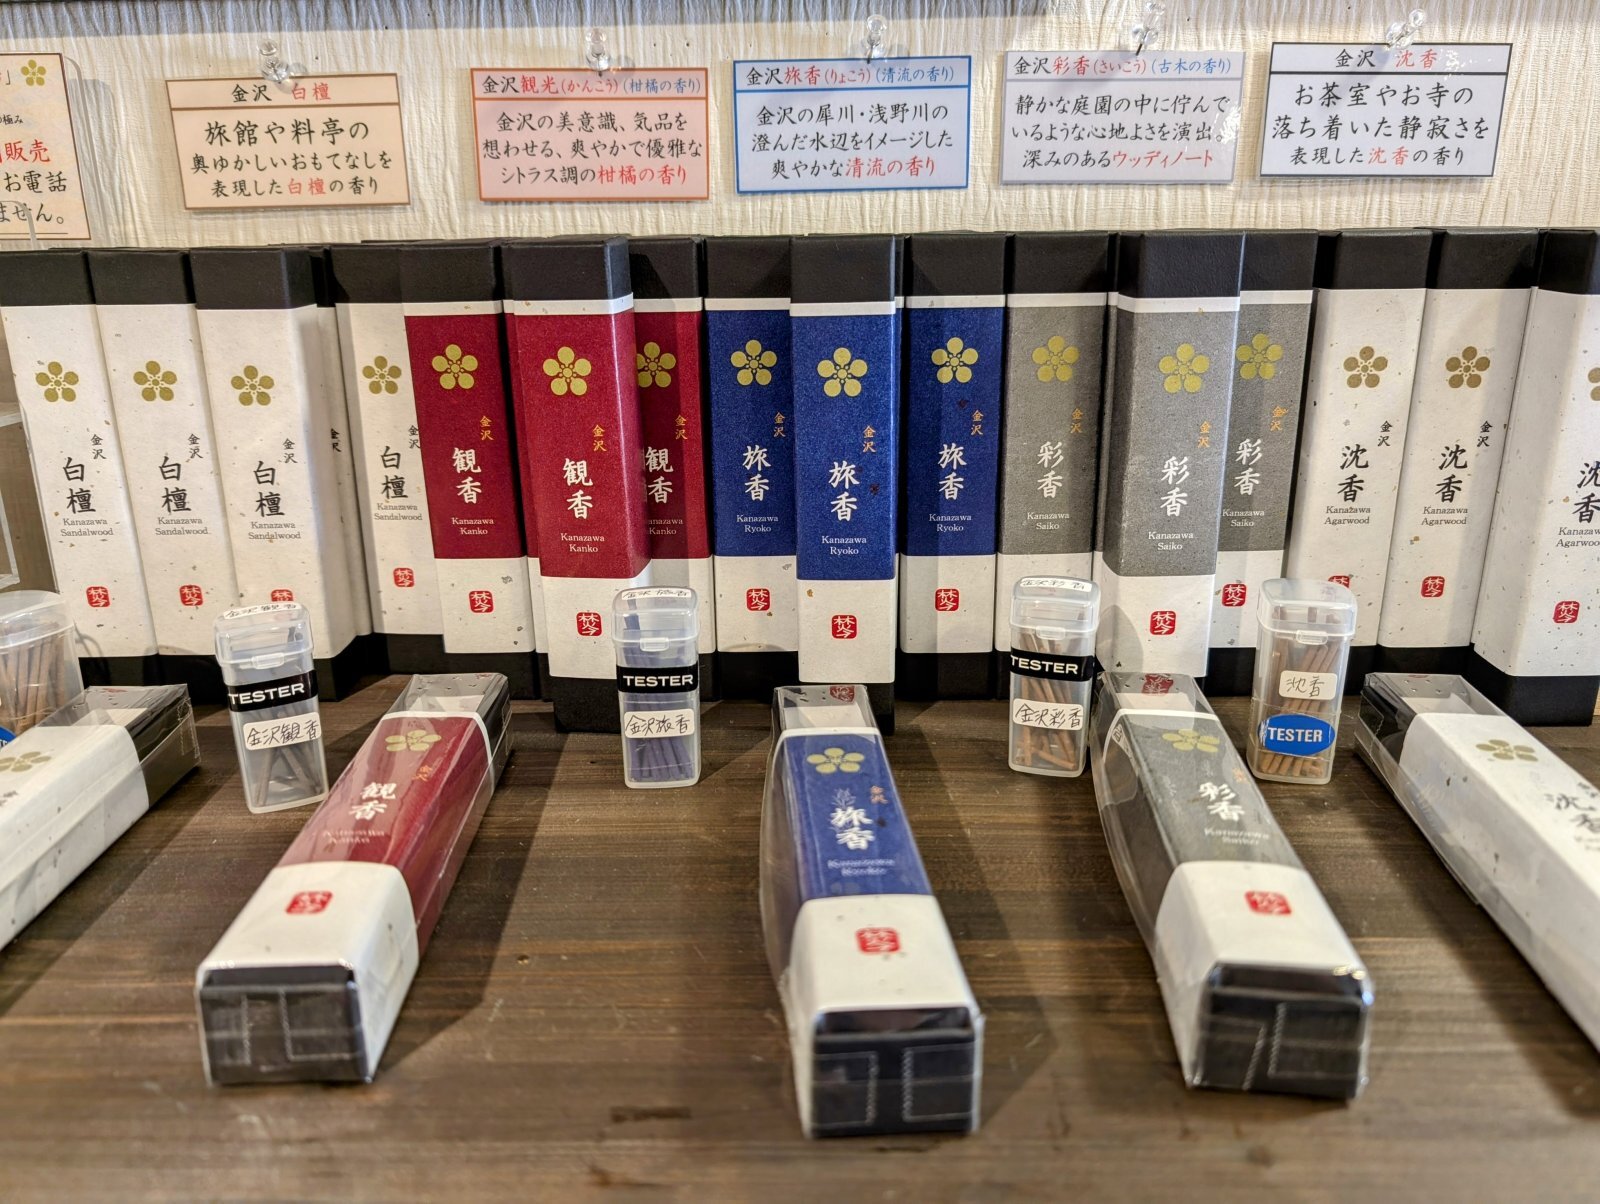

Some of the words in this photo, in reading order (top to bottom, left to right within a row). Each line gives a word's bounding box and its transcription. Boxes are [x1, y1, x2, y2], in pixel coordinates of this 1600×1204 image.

[1335, 48, 1375, 68] 金沢
[1395, 49, 1438, 68] 沈香
[231, 84, 272, 103] 金沢
[291, 82, 332, 101] 白檀
[1294, 82, 1473, 108] お茶室やお寺の
[756, 103, 948, 126] 金沢の犀川・浅野川の
[1015, 93, 1230, 116] 静かな庭園の中に佇んで
[0, 114, 24, 124] 極み
[497, 111, 688, 133] 金沢の美意識、気品を
[1272, 115, 1489, 141] 落ち着いた静寂さを
[204, 118, 370, 147] 旅館や料亭の
[751, 130, 953, 152] 澄んだ水辺をイメージした
[1011, 122, 1224, 142] いるような心地よさを演出。
[0, 139, 51, 164] 販売
[482, 138, 703, 160] 想わせる、爽やかで優雅な
[1022, 149, 1213, 169] 深みのあるウッディノート
[1290, 146, 1463, 166] 表現した沈香の香り
[190, 151, 392, 175] 奥ゆかしいおもてなしを
[771, 155, 935, 180] 爽やかな清流の香り
[3, 170, 67, 193] お電話
[501, 164, 687, 186] シトラス調の柑橘の香り
[211, 176, 379, 197] 表現した白檀の香り
[479, 415, 494, 441] 金沢
[675, 414, 688, 440] 金沢
[774, 412, 787, 438] 金沢
[970, 410, 984, 436] 金沢
[1070, 408, 1083, 434] 金沢
[1270, 405, 1287, 431] 金沢
[408, 425, 421, 449] 金沢
[592, 425, 607, 452] 金沢
[863, 425, 876, 453] 金沢
[1198, 421, 1212, 448] 金沢
[1377, 420, 1393, 447] 金沢
[1477, 420, 1493, 448] 金沢
[91, 433, 107, 460] 金沢
[188, 433, 204, 459] 金沢
[282, 438, 299, 464] 金沢
[381, 445, 409, 500] 白檀
[452, 447, 482, 504] 観香
[645, 446, 674, 504] 観香
[742, 444, 771, 502] 旅香
[938, 443, 967, 501] 旅香
[1037, 441, 1064, 499] 彩香
[1234, 438, 1262, 496] 彩香
[1337, 444, 1369, 503] 沈香
[1435, 444, 1469, 503] 沈香
[62, 457, 96, 514] 白檀
[159, 456, 192, 513] 白檀
[253, 460, 285, 518] 白檀
[562, 458, 594, 520] 観香
[829, 460, 860, 522] 旅香
[1160, 456, 1190, 517] 彩香
[374, 512, 423, 521] Sandalwood
[377, 503, 418, 511] Kanazawa
[736, 514, 779, 522] Kanazawa
[929, 513, 972, 522] Kanazawa
[1027, 512, 1070, 520] Kanazawa
[1222, 508, 1265, 517] Kanazawa
[1325, 506, 1371, 514] Kanazawa
[1423, 506, 1469, 515] Kanazawa
[63, 518, 108, 526] Kanazawa
[155, 527, 208, 536] Sandalwood
[158, 517, 203, 525] Kanazawa
[251, 521, 296, 529] Kanazawa
[452, 517, 494, 525] Kanazawa
[460, 527, 488, 536] Kanko
[649, 517, 684, 525] anazawa
[649, 527, 677, 535] Kanko
[744, 525, 771, 533] Ryoko
[936, 523, 964, 532] Ryoko
[1036, 522, 1060, 530] Saiko
[1231, 519, 1255, 527] Saiko
[1324, 516, 1370, 526] Agarwood
[1421, 517, 1467, 526] Agarwood
[1558, 527, 1600, 536] Kanazaw
[60, 528, 114, 537] Sandalwood
[248, 531, 301, 540] Sandalwood
[560, 532, 605, 542] Kanazawa
[821, 536, 867, 545] Kanazawa
[1148, 531, 1194, 540] Kanazawa
[1556, 539, 1600, 548] Agarwoo
[569, 544, 599, 553] Kanko
[830, 546, 860, 555] Ryoko
[1157, 542, 1183, 551] Saiko
[1010, 654, 1079, 675] TESTER
[623, 675, 694, 687] TESTER
[228, 683, 305, 705] TESTER
[1267, 727, 1323, 743] TESTER
